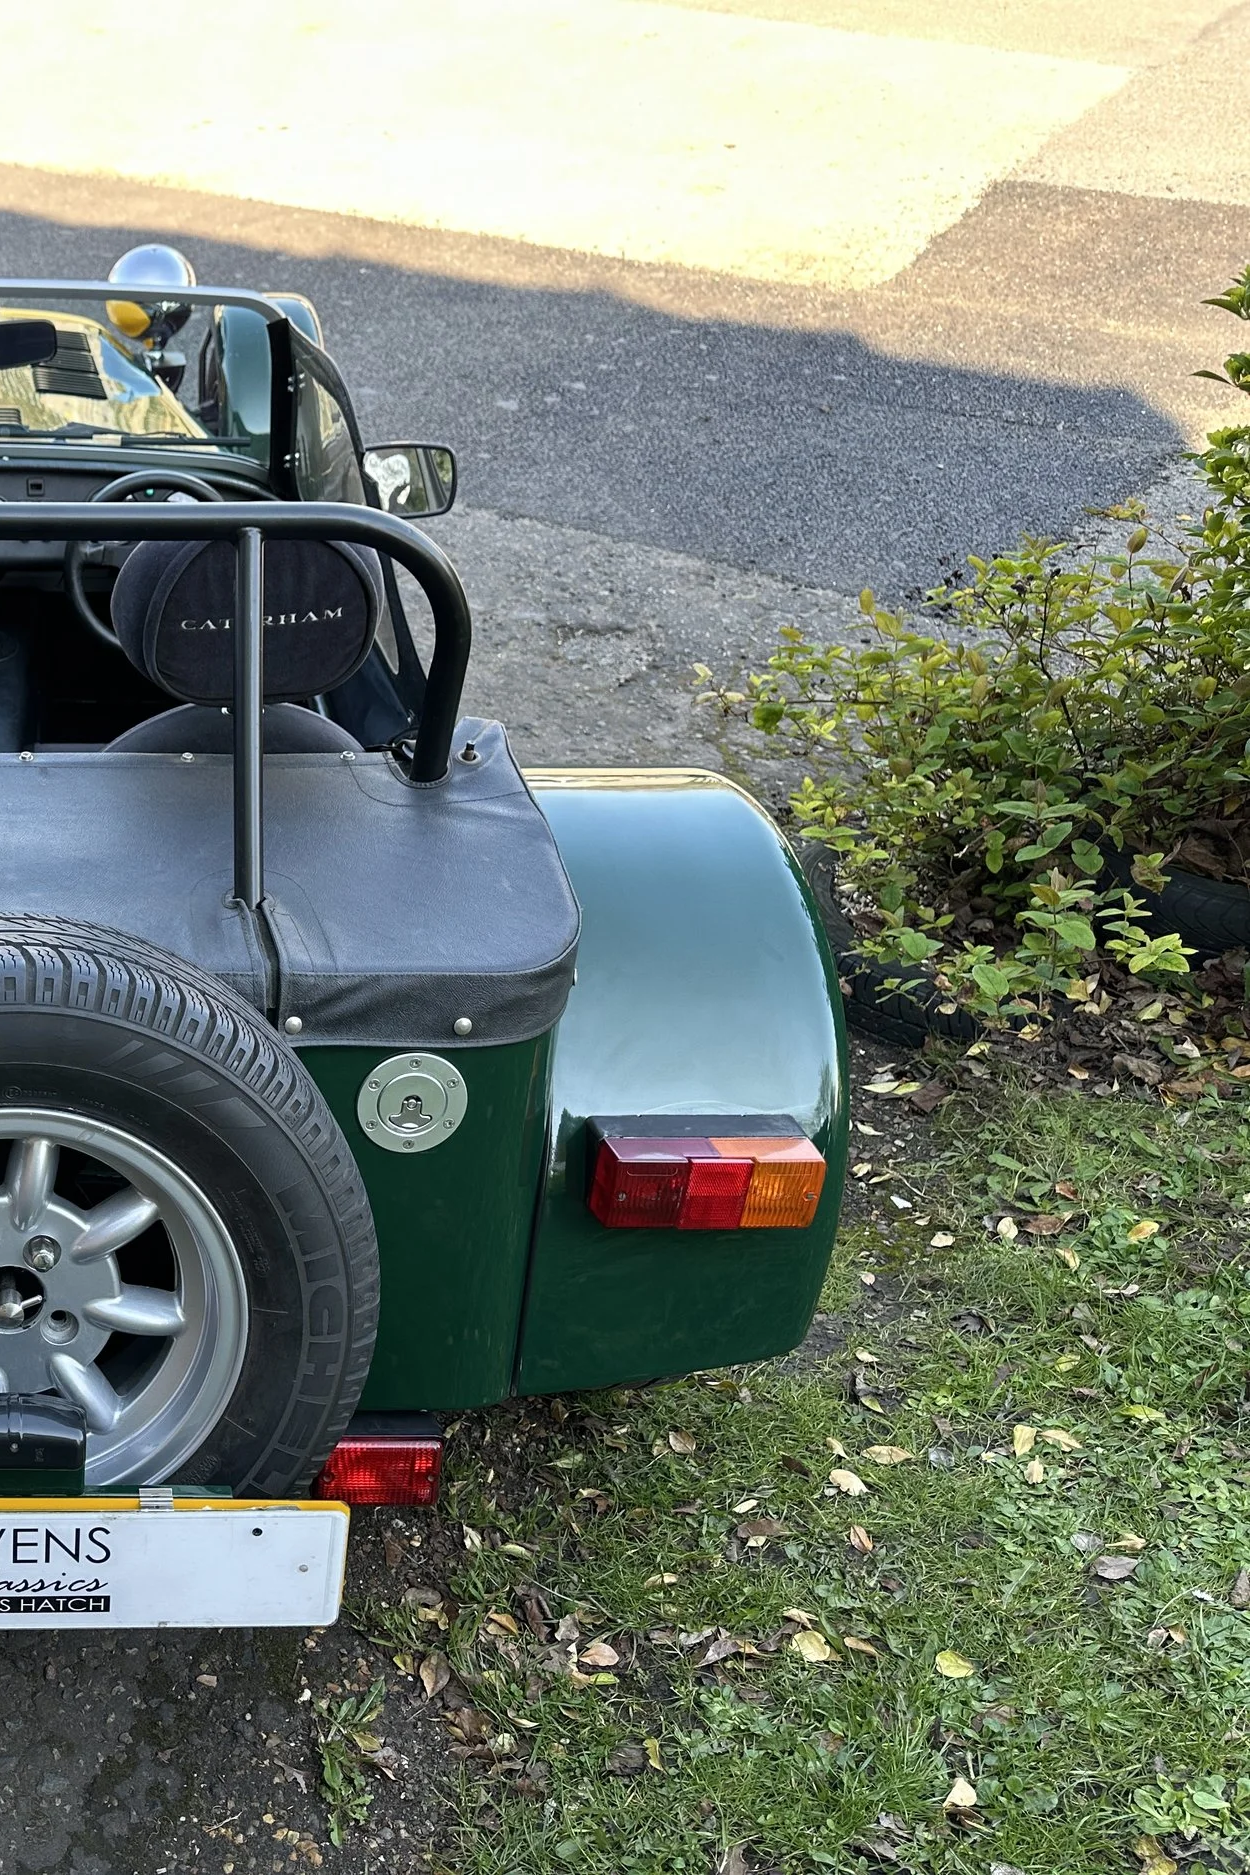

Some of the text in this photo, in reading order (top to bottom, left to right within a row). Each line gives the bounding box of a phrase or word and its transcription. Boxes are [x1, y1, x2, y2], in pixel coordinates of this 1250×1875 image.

[180, 606, 343, 630] CATRHAM
[240, 1178, 344, 1498] MICHEL
[19, 1597, 105, 1612] HATCH
